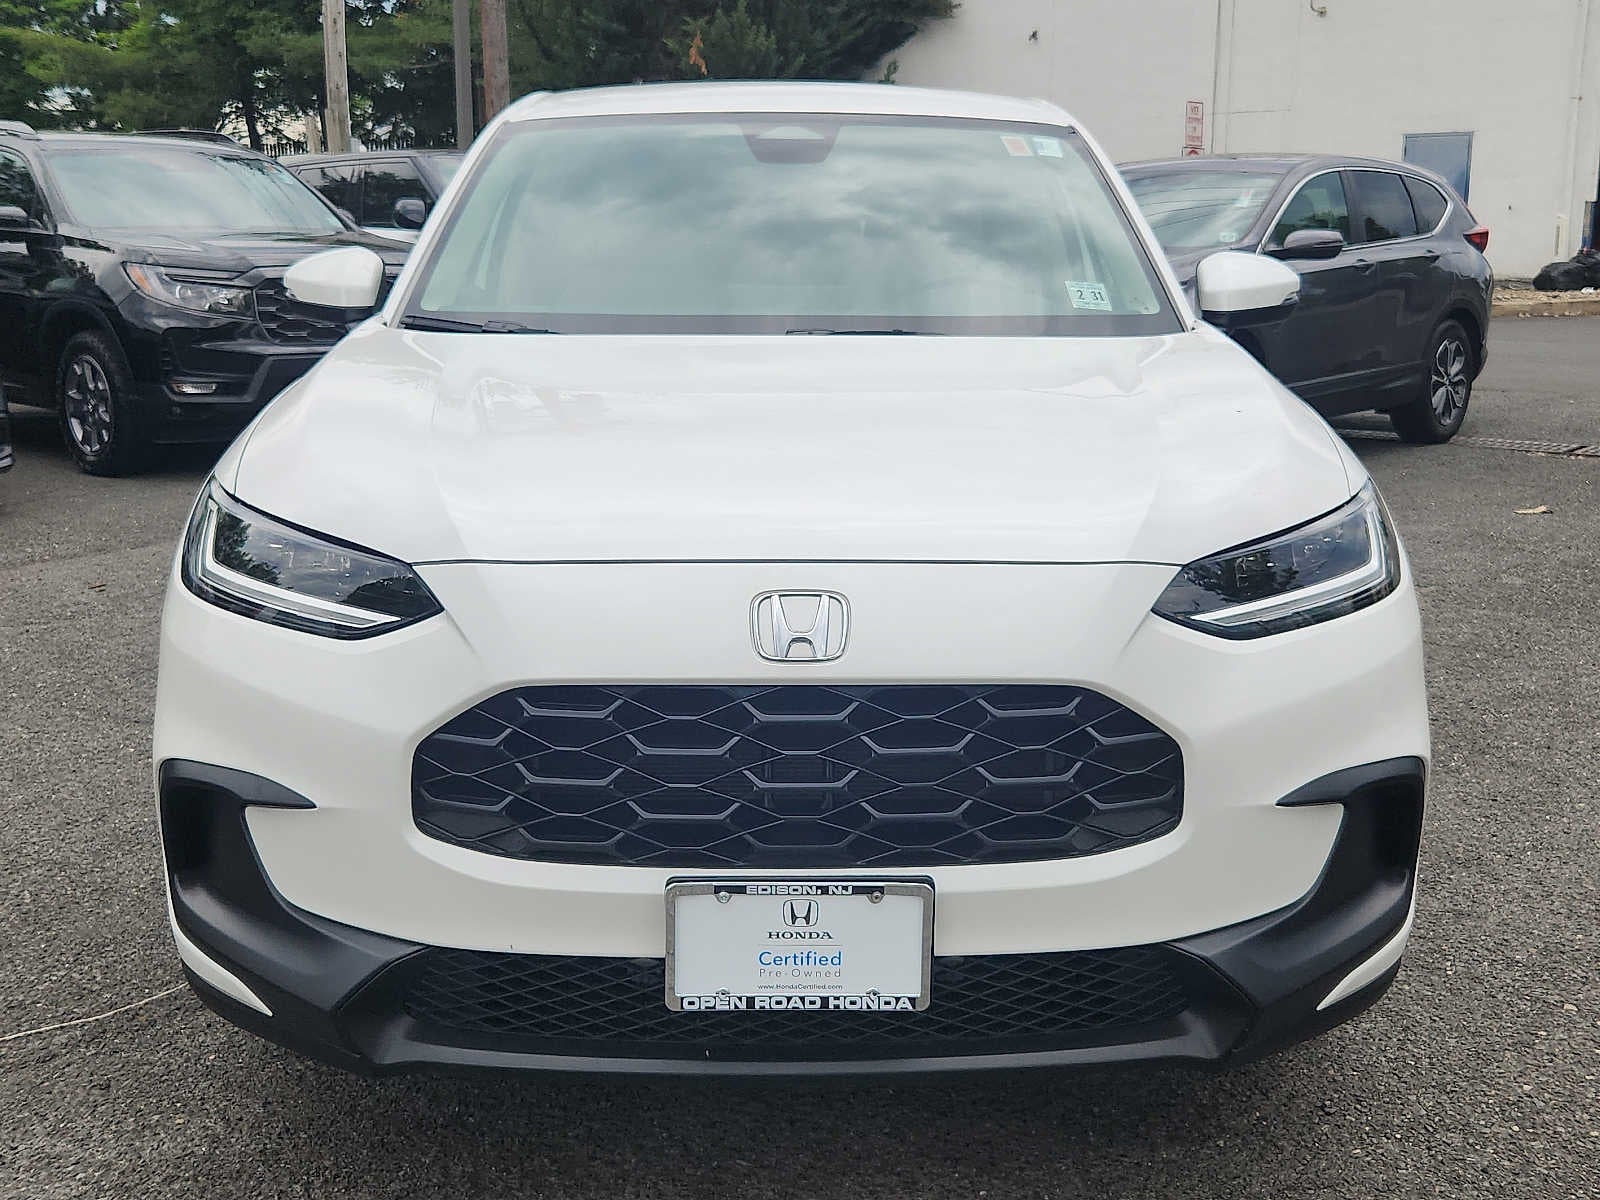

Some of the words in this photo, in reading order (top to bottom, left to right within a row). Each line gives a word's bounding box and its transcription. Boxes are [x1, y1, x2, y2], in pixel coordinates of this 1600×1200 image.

[1076, 289, 1085, 300] 2
[1090, 290, 1105, 301] 31
[828, 885, 853, 896] NJ
[767, 931, 833, 940] HONDA
[758, 950, 842, 967] Certified
[759, 968, 841, 978] Pre-Owned
[757, 983, 843, 991] www.HondaCertified.com
[682, 996, 747, 1010] OPEN
[755, 996, 821, 1010] ROAD
[829, 996, 913, 1010] HONDA
